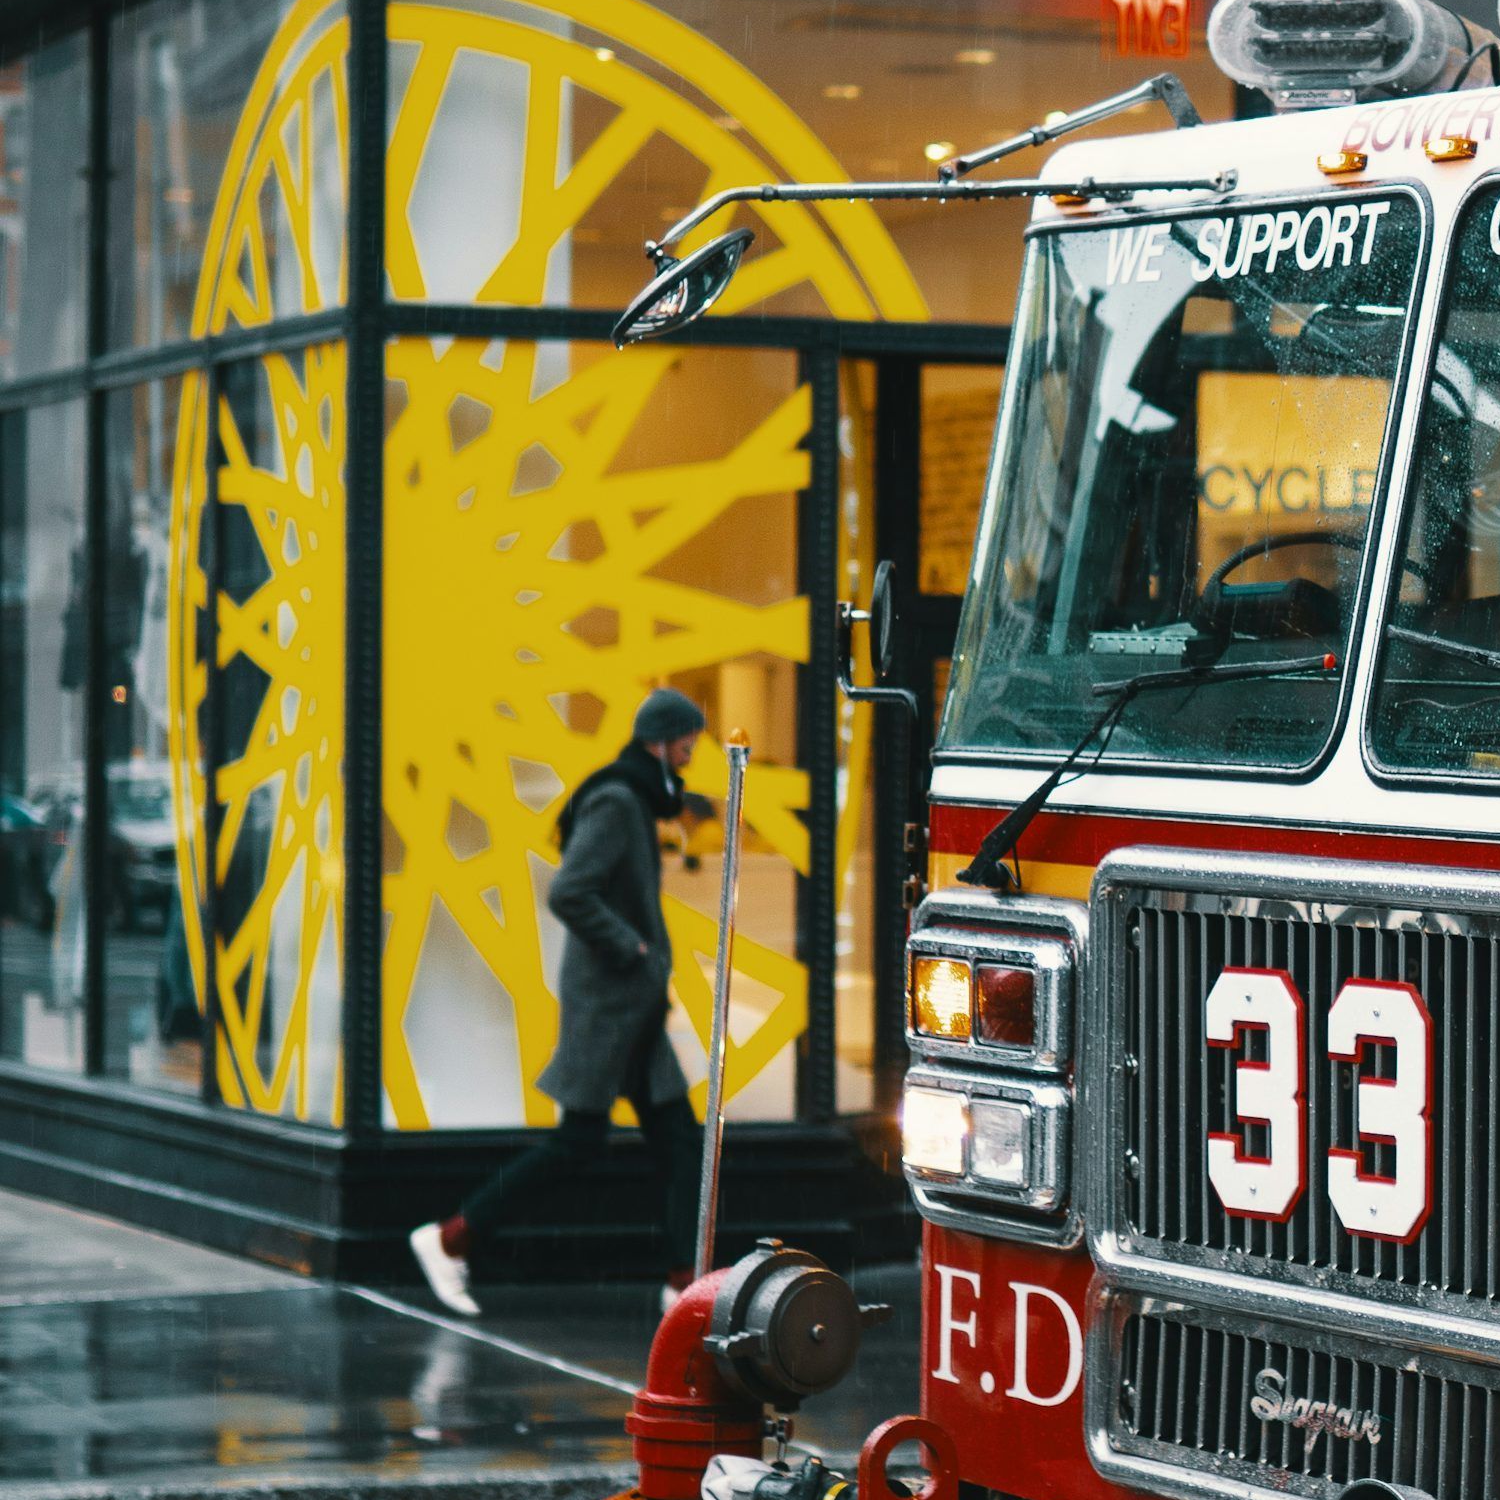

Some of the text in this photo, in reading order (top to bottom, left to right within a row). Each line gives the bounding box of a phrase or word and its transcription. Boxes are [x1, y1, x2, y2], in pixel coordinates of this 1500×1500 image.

[1105, 221, 1172, 286] WE
[1191, 201, 1391, 282] SUPPORT
[1200, 464, 1377, 514] CYCLE
[1205, 965, 1435, 1245] 33
